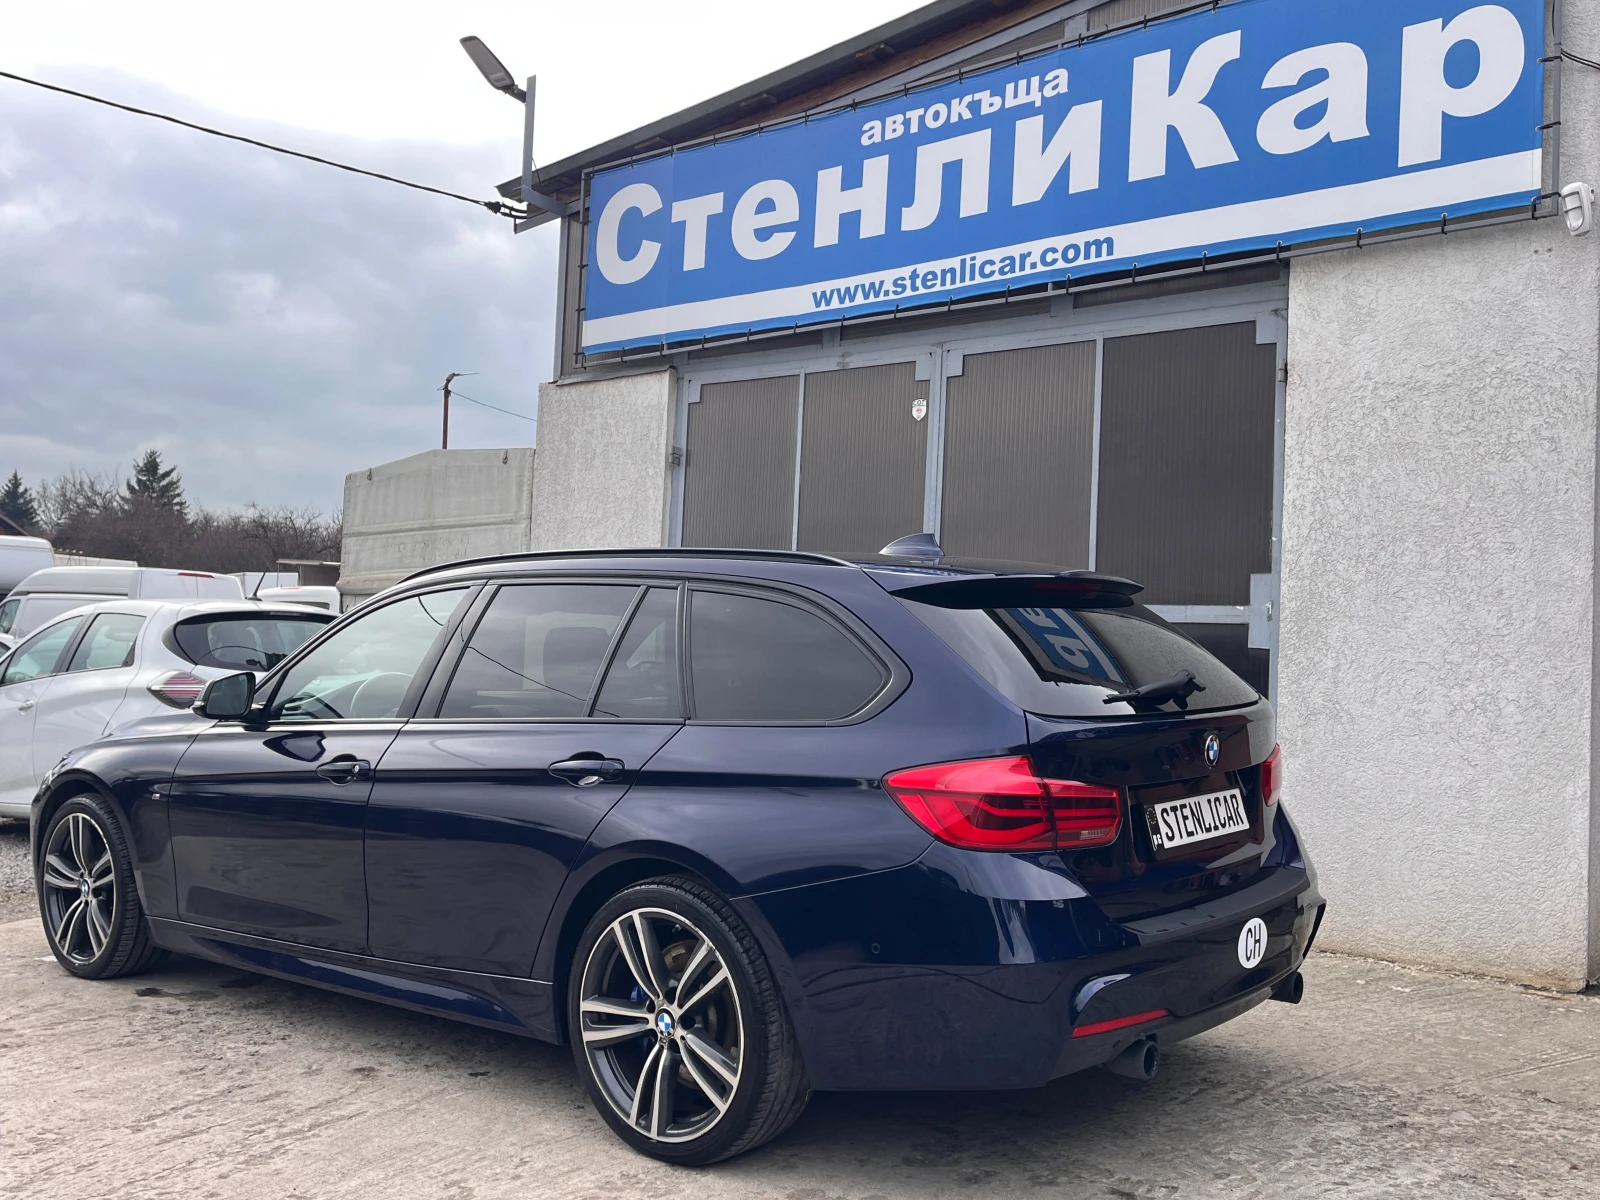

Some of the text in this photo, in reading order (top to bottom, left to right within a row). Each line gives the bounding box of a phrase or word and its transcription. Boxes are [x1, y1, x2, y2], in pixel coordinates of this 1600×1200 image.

[861, 69, 1069, 146] автокъща
[597, 5, 1524, 284] СтенлиКар
[812, 236, 1114, 308] www.stenlicar.com
[1161, 794, 1244, 842] STENLICAR
[1246, 923, 1261, 962] CH
